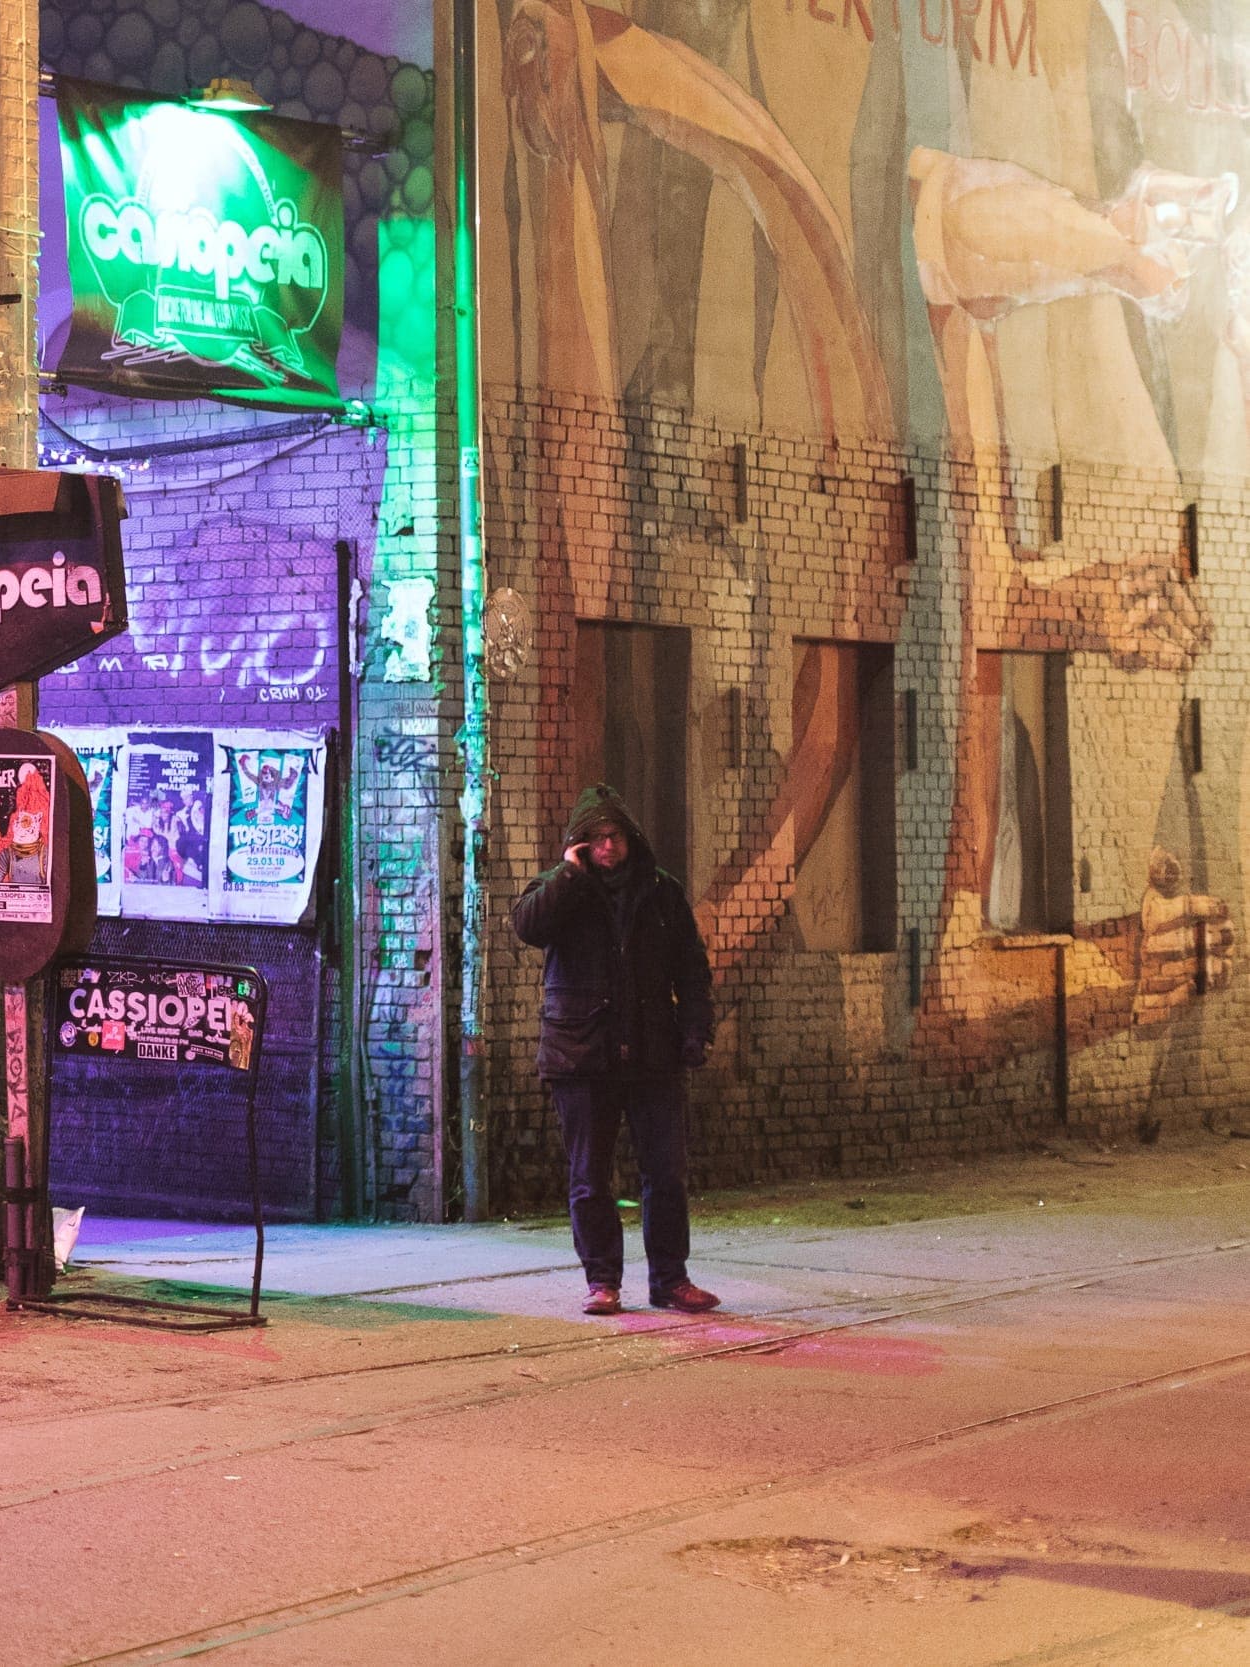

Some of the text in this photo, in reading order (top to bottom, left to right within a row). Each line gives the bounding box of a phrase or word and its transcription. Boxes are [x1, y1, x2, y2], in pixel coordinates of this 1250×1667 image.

[170, 761, 189, 769] VON
[161, 768, 197, 777] NELKEN
[155, 782, 200, 792] PRALINEN
[229, 824, 304, 848] TOASTERS!
[247, 857, 285, 866] 29.03.18
[139, 1044, 175, 1059] DANKE
